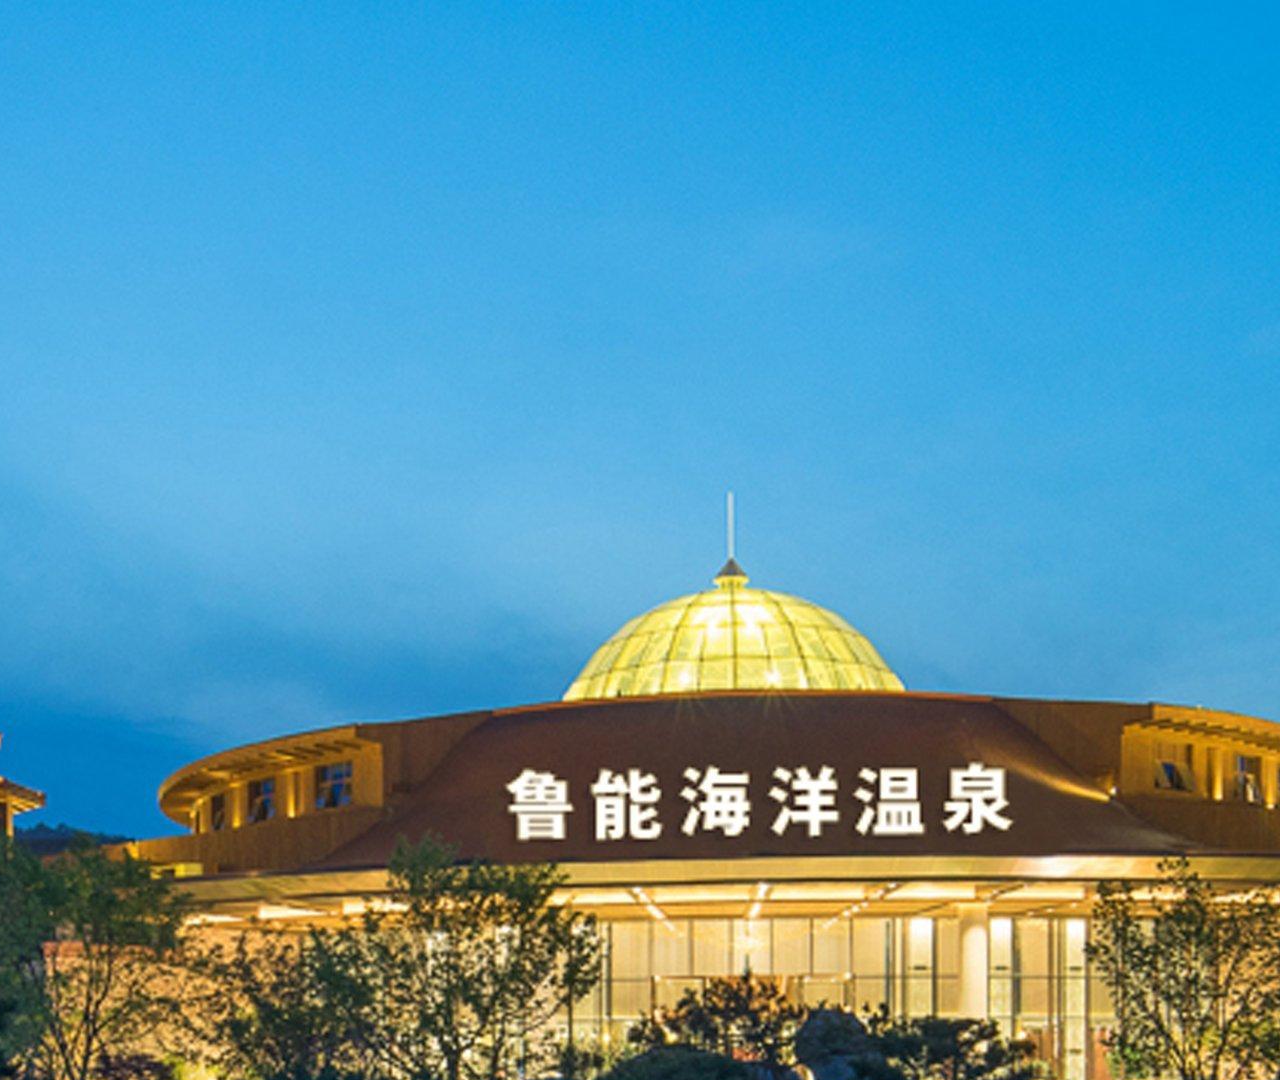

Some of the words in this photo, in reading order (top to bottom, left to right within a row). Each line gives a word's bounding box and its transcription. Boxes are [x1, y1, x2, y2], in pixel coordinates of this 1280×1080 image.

[506, 763, 1013, 841] 鲁能海洋温泉
